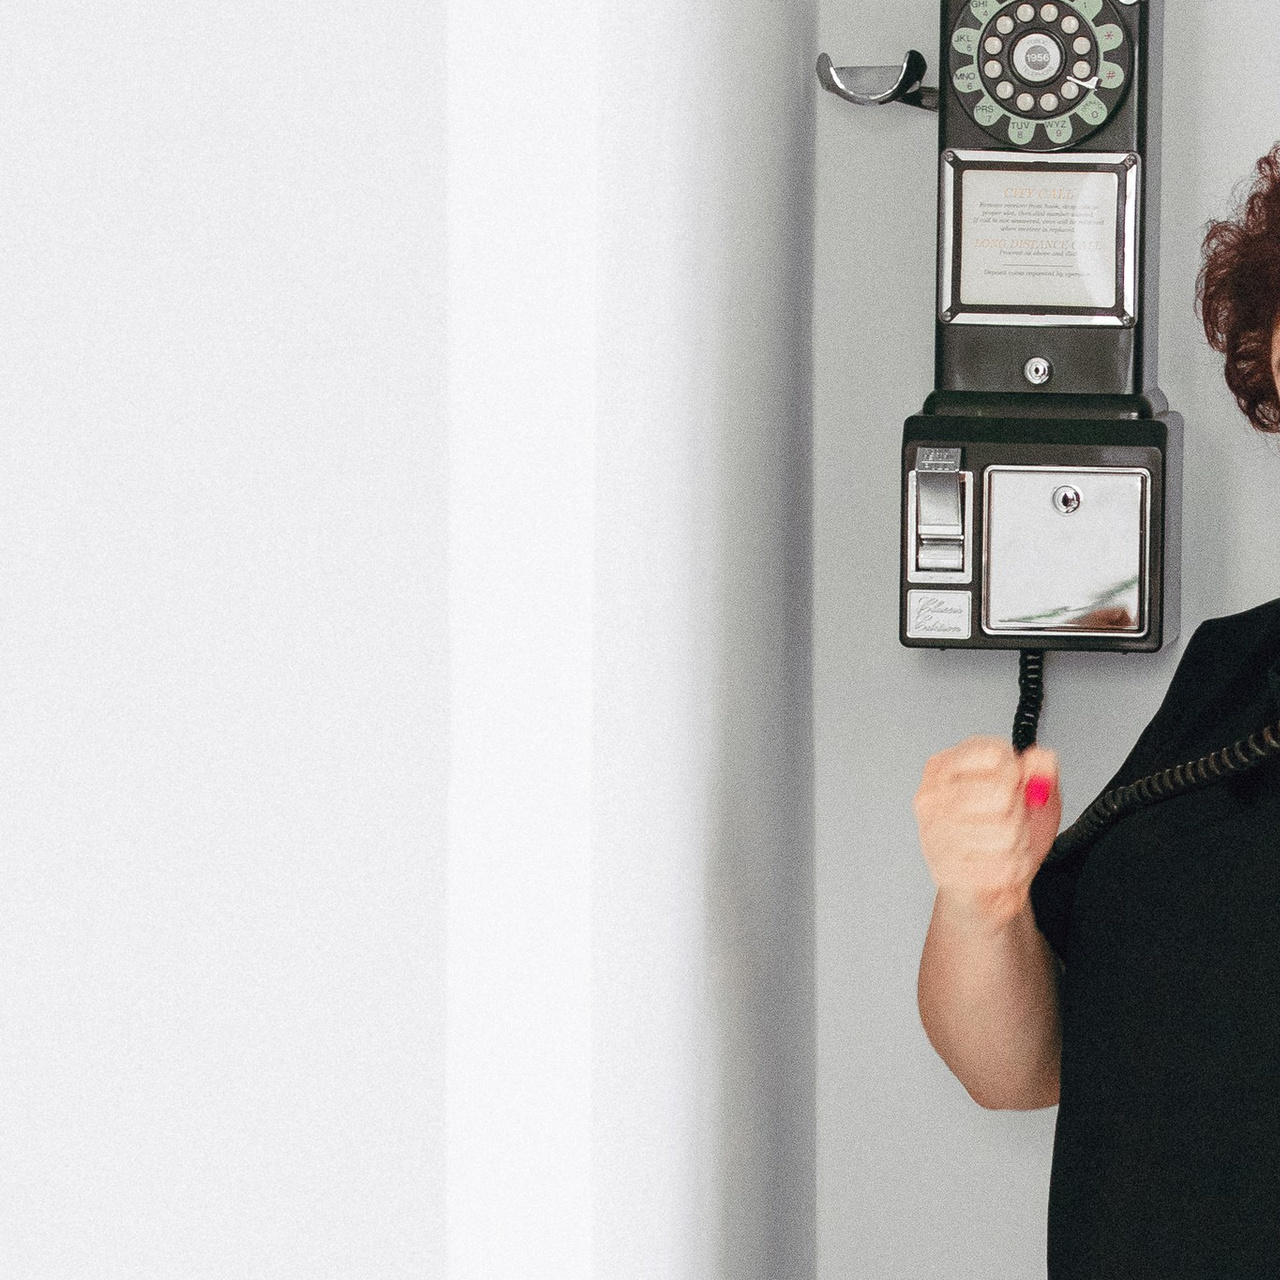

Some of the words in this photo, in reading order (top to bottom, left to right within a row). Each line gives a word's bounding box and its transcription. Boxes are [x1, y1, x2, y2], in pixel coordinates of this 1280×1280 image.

[970, 0, 988, 8] GHI
[1026, 53, 1049, 62] 1956
[967, 82, 973, 90] 6
[976, 105, 994, 113] PRS
